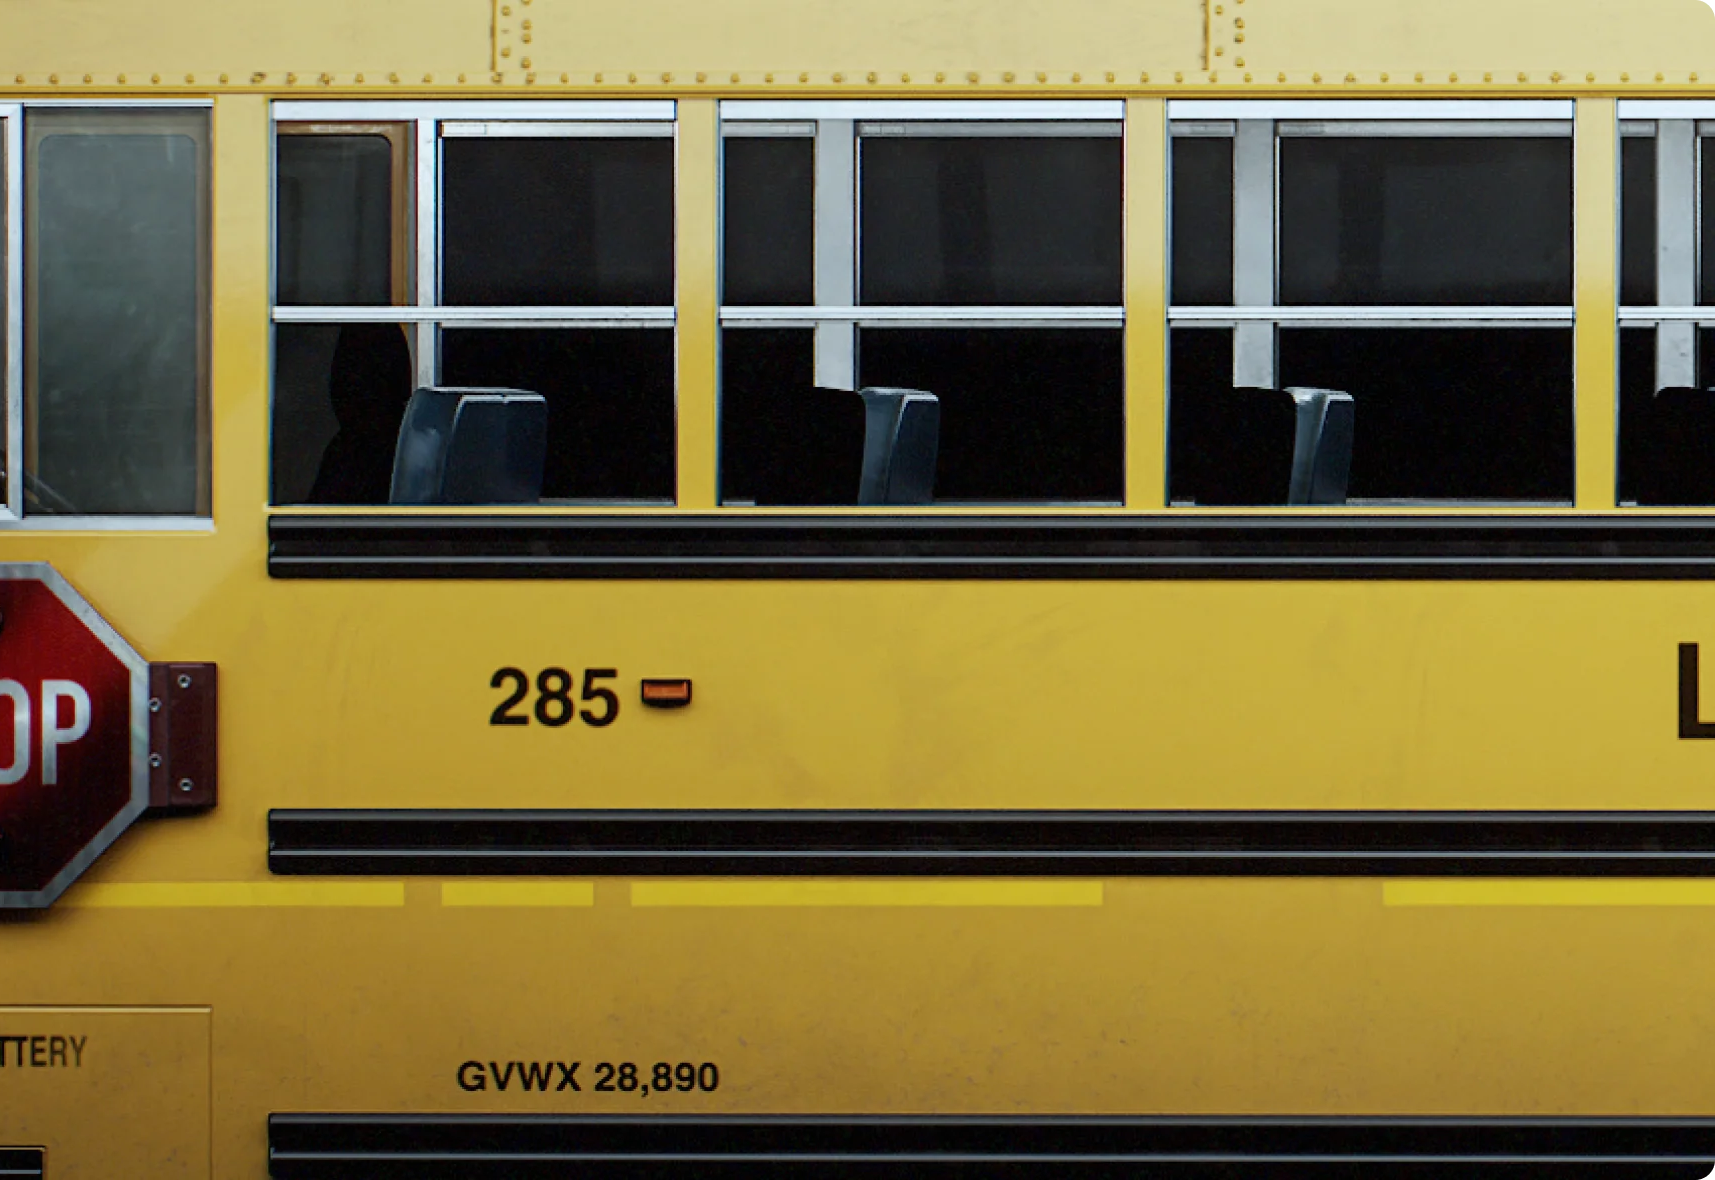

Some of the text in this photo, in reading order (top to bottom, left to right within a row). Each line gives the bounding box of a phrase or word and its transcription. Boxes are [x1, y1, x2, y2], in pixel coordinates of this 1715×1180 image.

[489, 665, 620, 728] 285
[457, 1060, 720, 1098] GVWX 28,890
